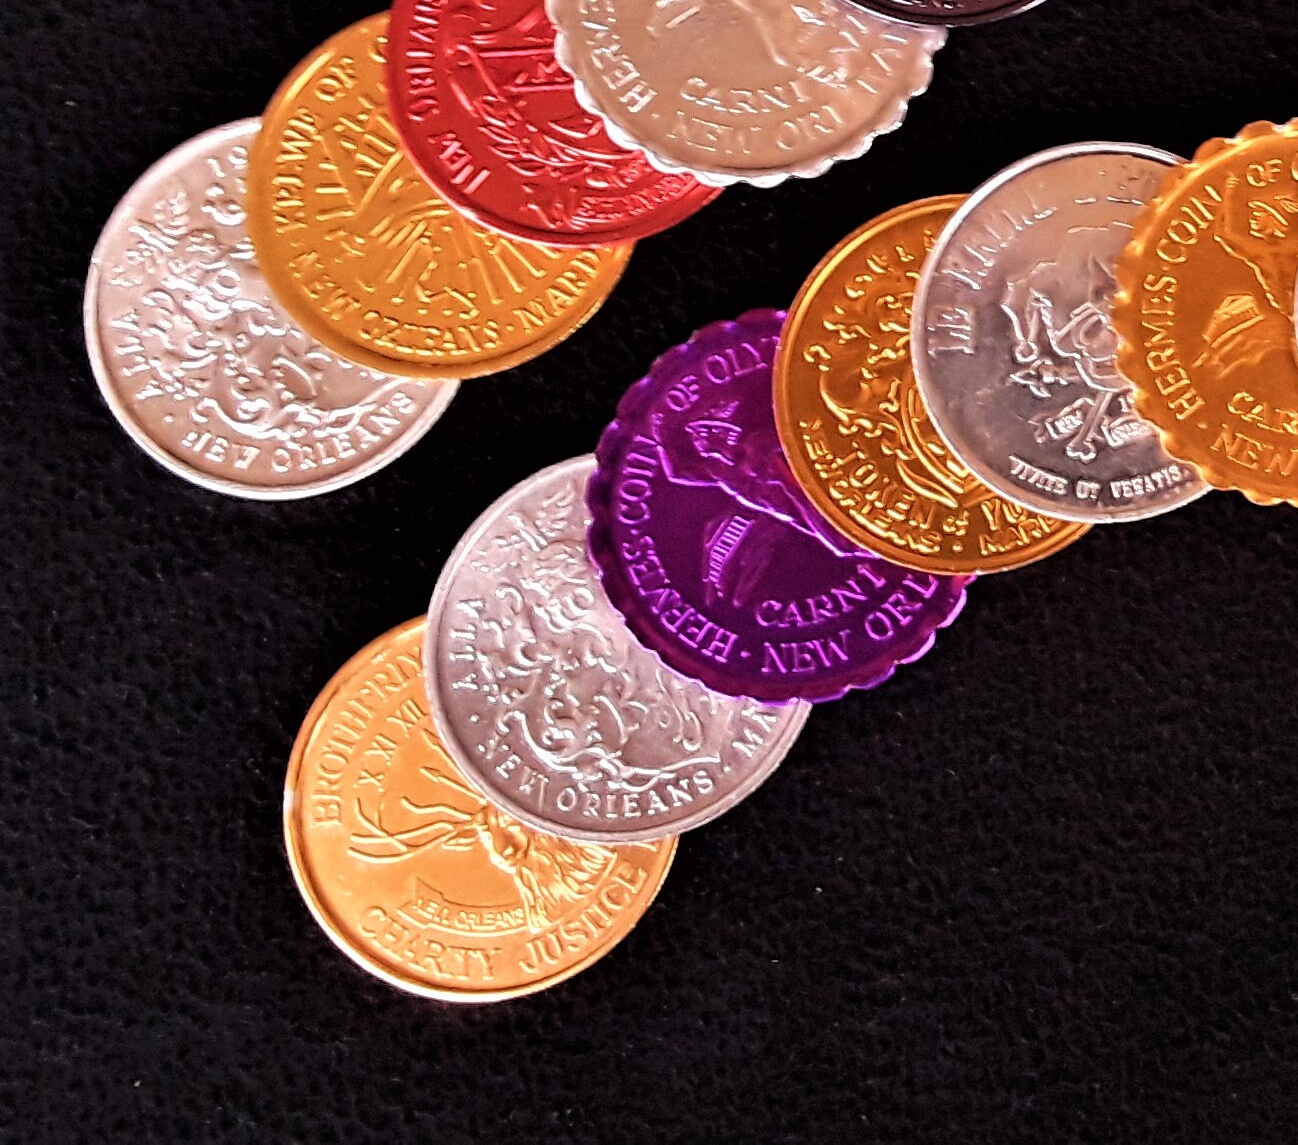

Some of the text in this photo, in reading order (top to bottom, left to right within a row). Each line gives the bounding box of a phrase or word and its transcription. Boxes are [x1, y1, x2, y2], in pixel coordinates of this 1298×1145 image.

[1242, 157, 1285, 191] OF
[1154, 182, 1227, 265] COIN
[1141, 270, 1202, 419] HERMES
[617, 433, 660, 526] COIN
[661, 372, 704, 415] OF
[447, 592, 484, 695] ALLA
[761, 625, 861, 673] NEW
[554, 770, 715, 820] ORLEANS
[516, 859, 646, 981] JUSTICE
